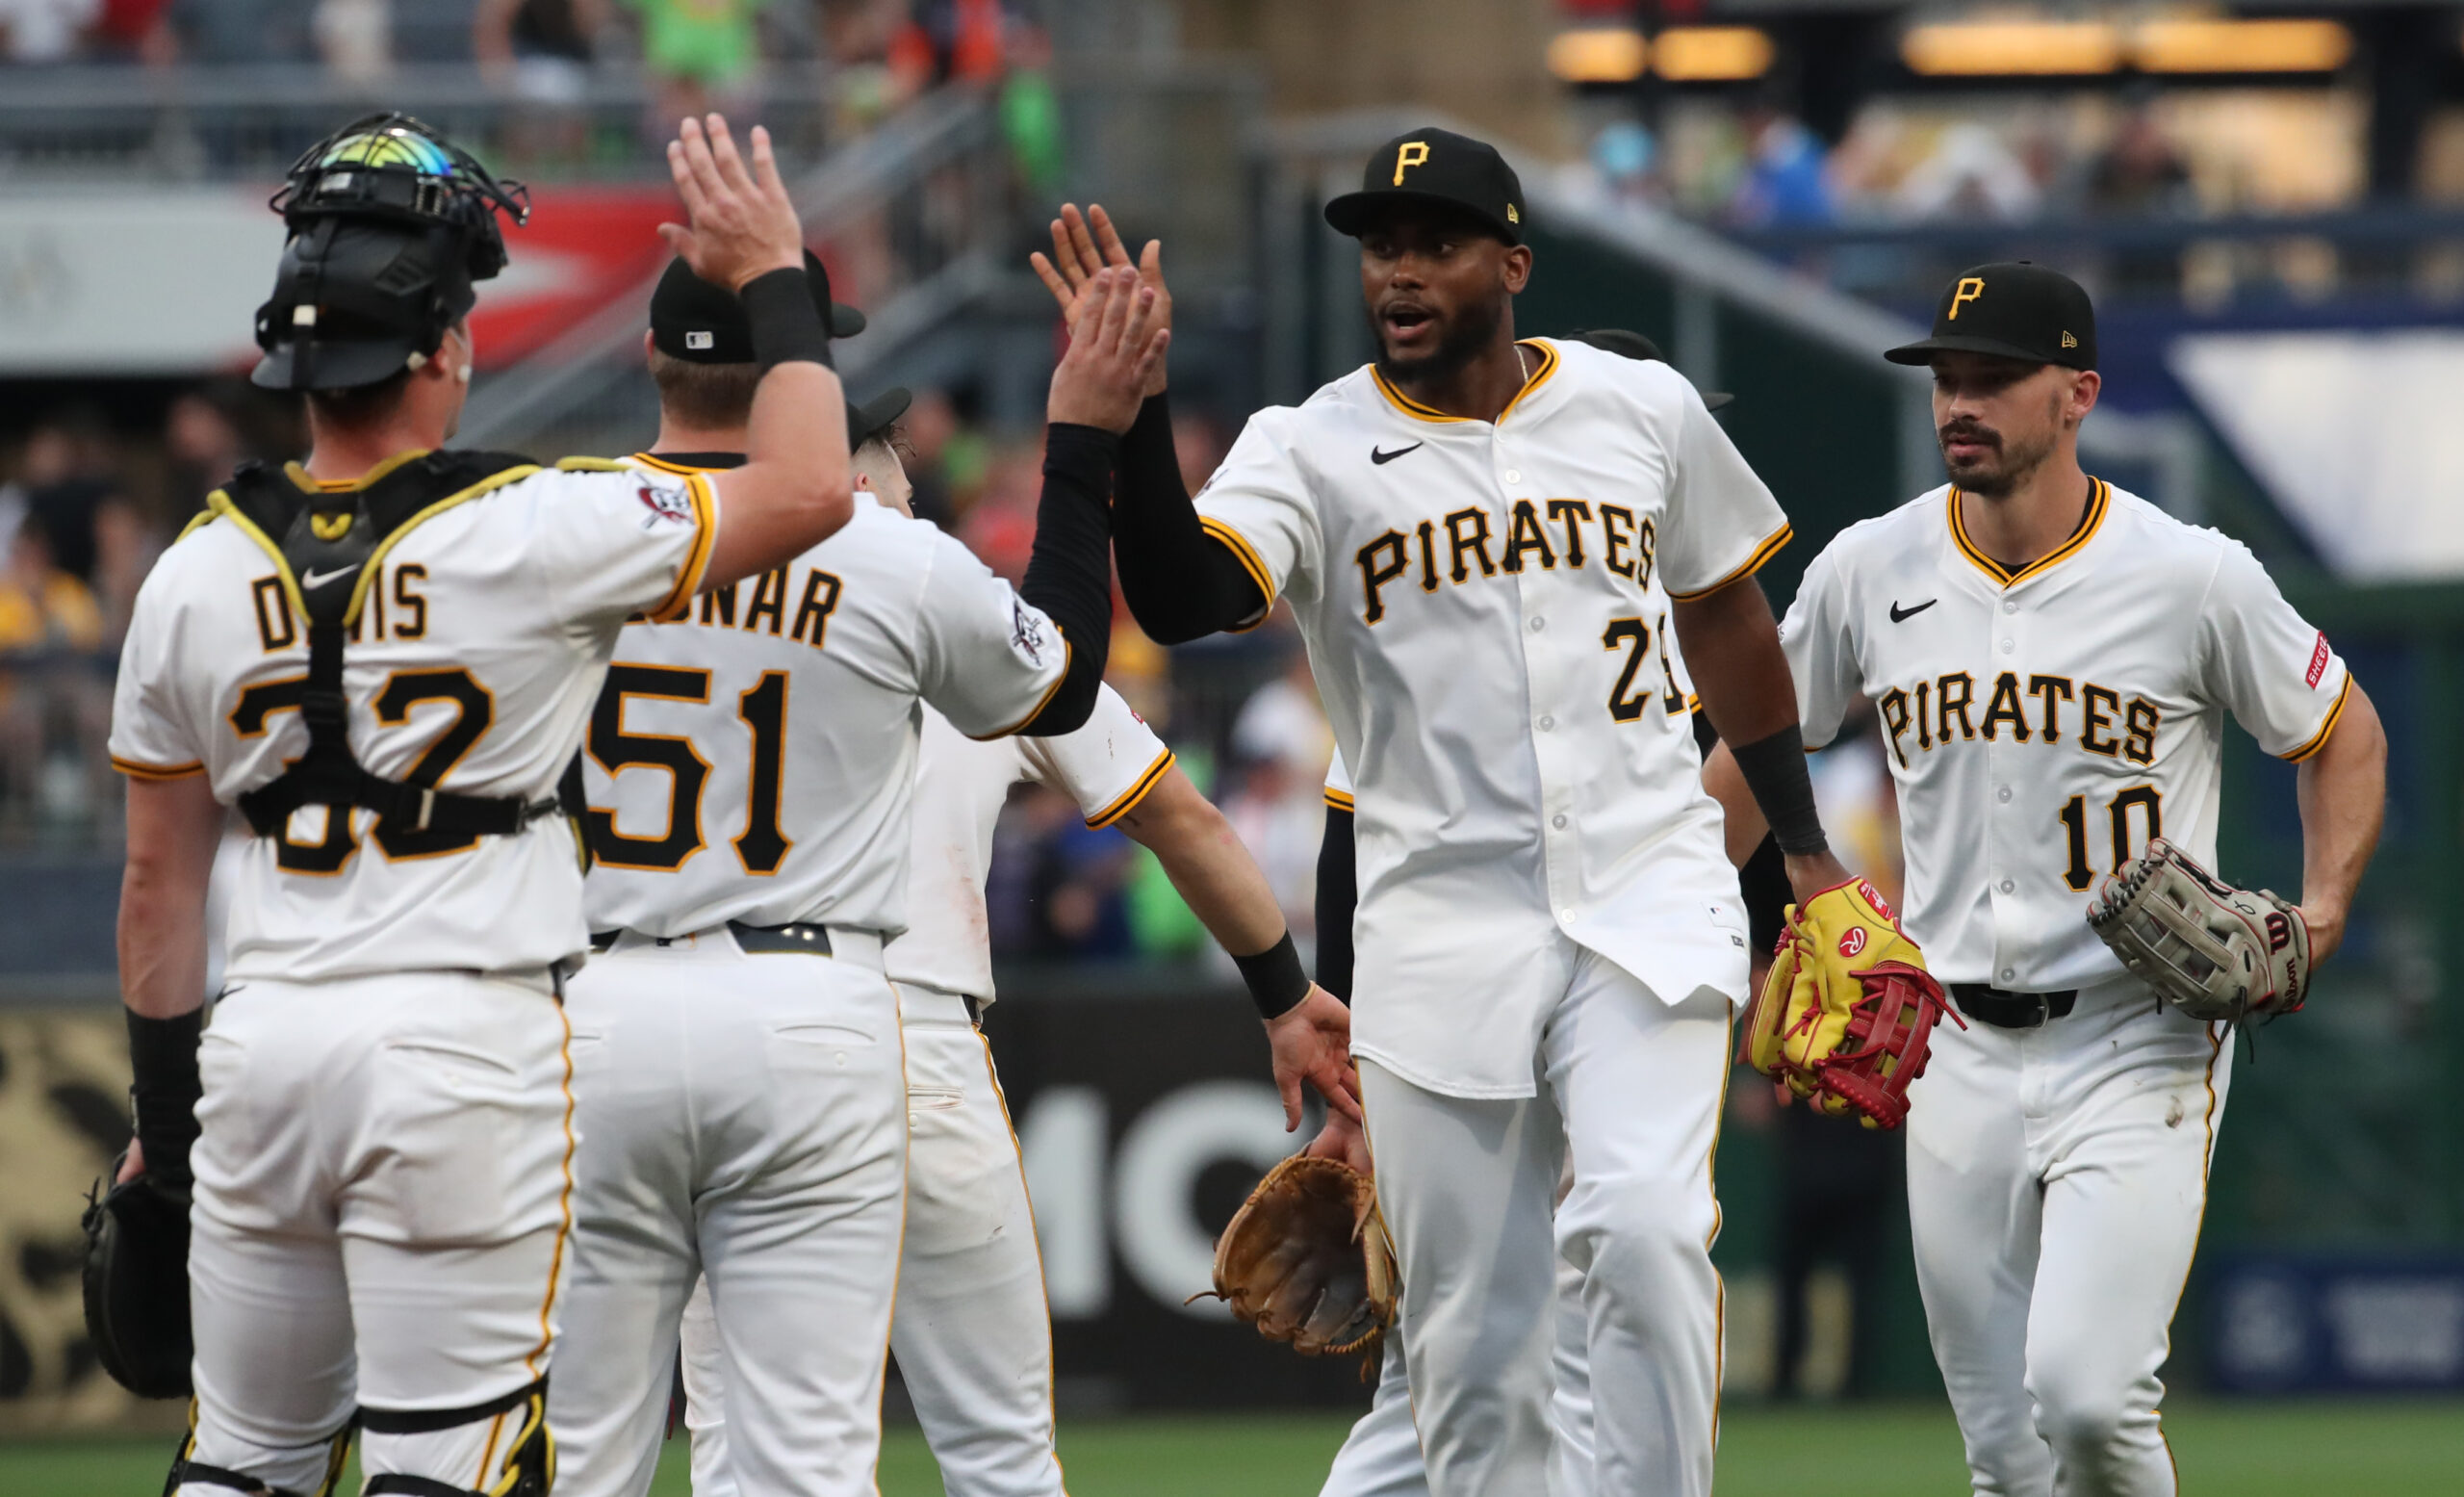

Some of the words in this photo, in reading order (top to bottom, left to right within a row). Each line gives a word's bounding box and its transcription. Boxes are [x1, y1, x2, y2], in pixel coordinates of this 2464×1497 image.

[1393, 142, 1430, 187] P
[1948, 277, 1986, 321] P
[251, 563, 427, 655] DIS
[1354, 499, 1656, 627] PIRATES
[585, 661, 794, 876] 51
[1880, 670, 2162, 770] PIRATES
[2059, 784, 2164, 892] 10
